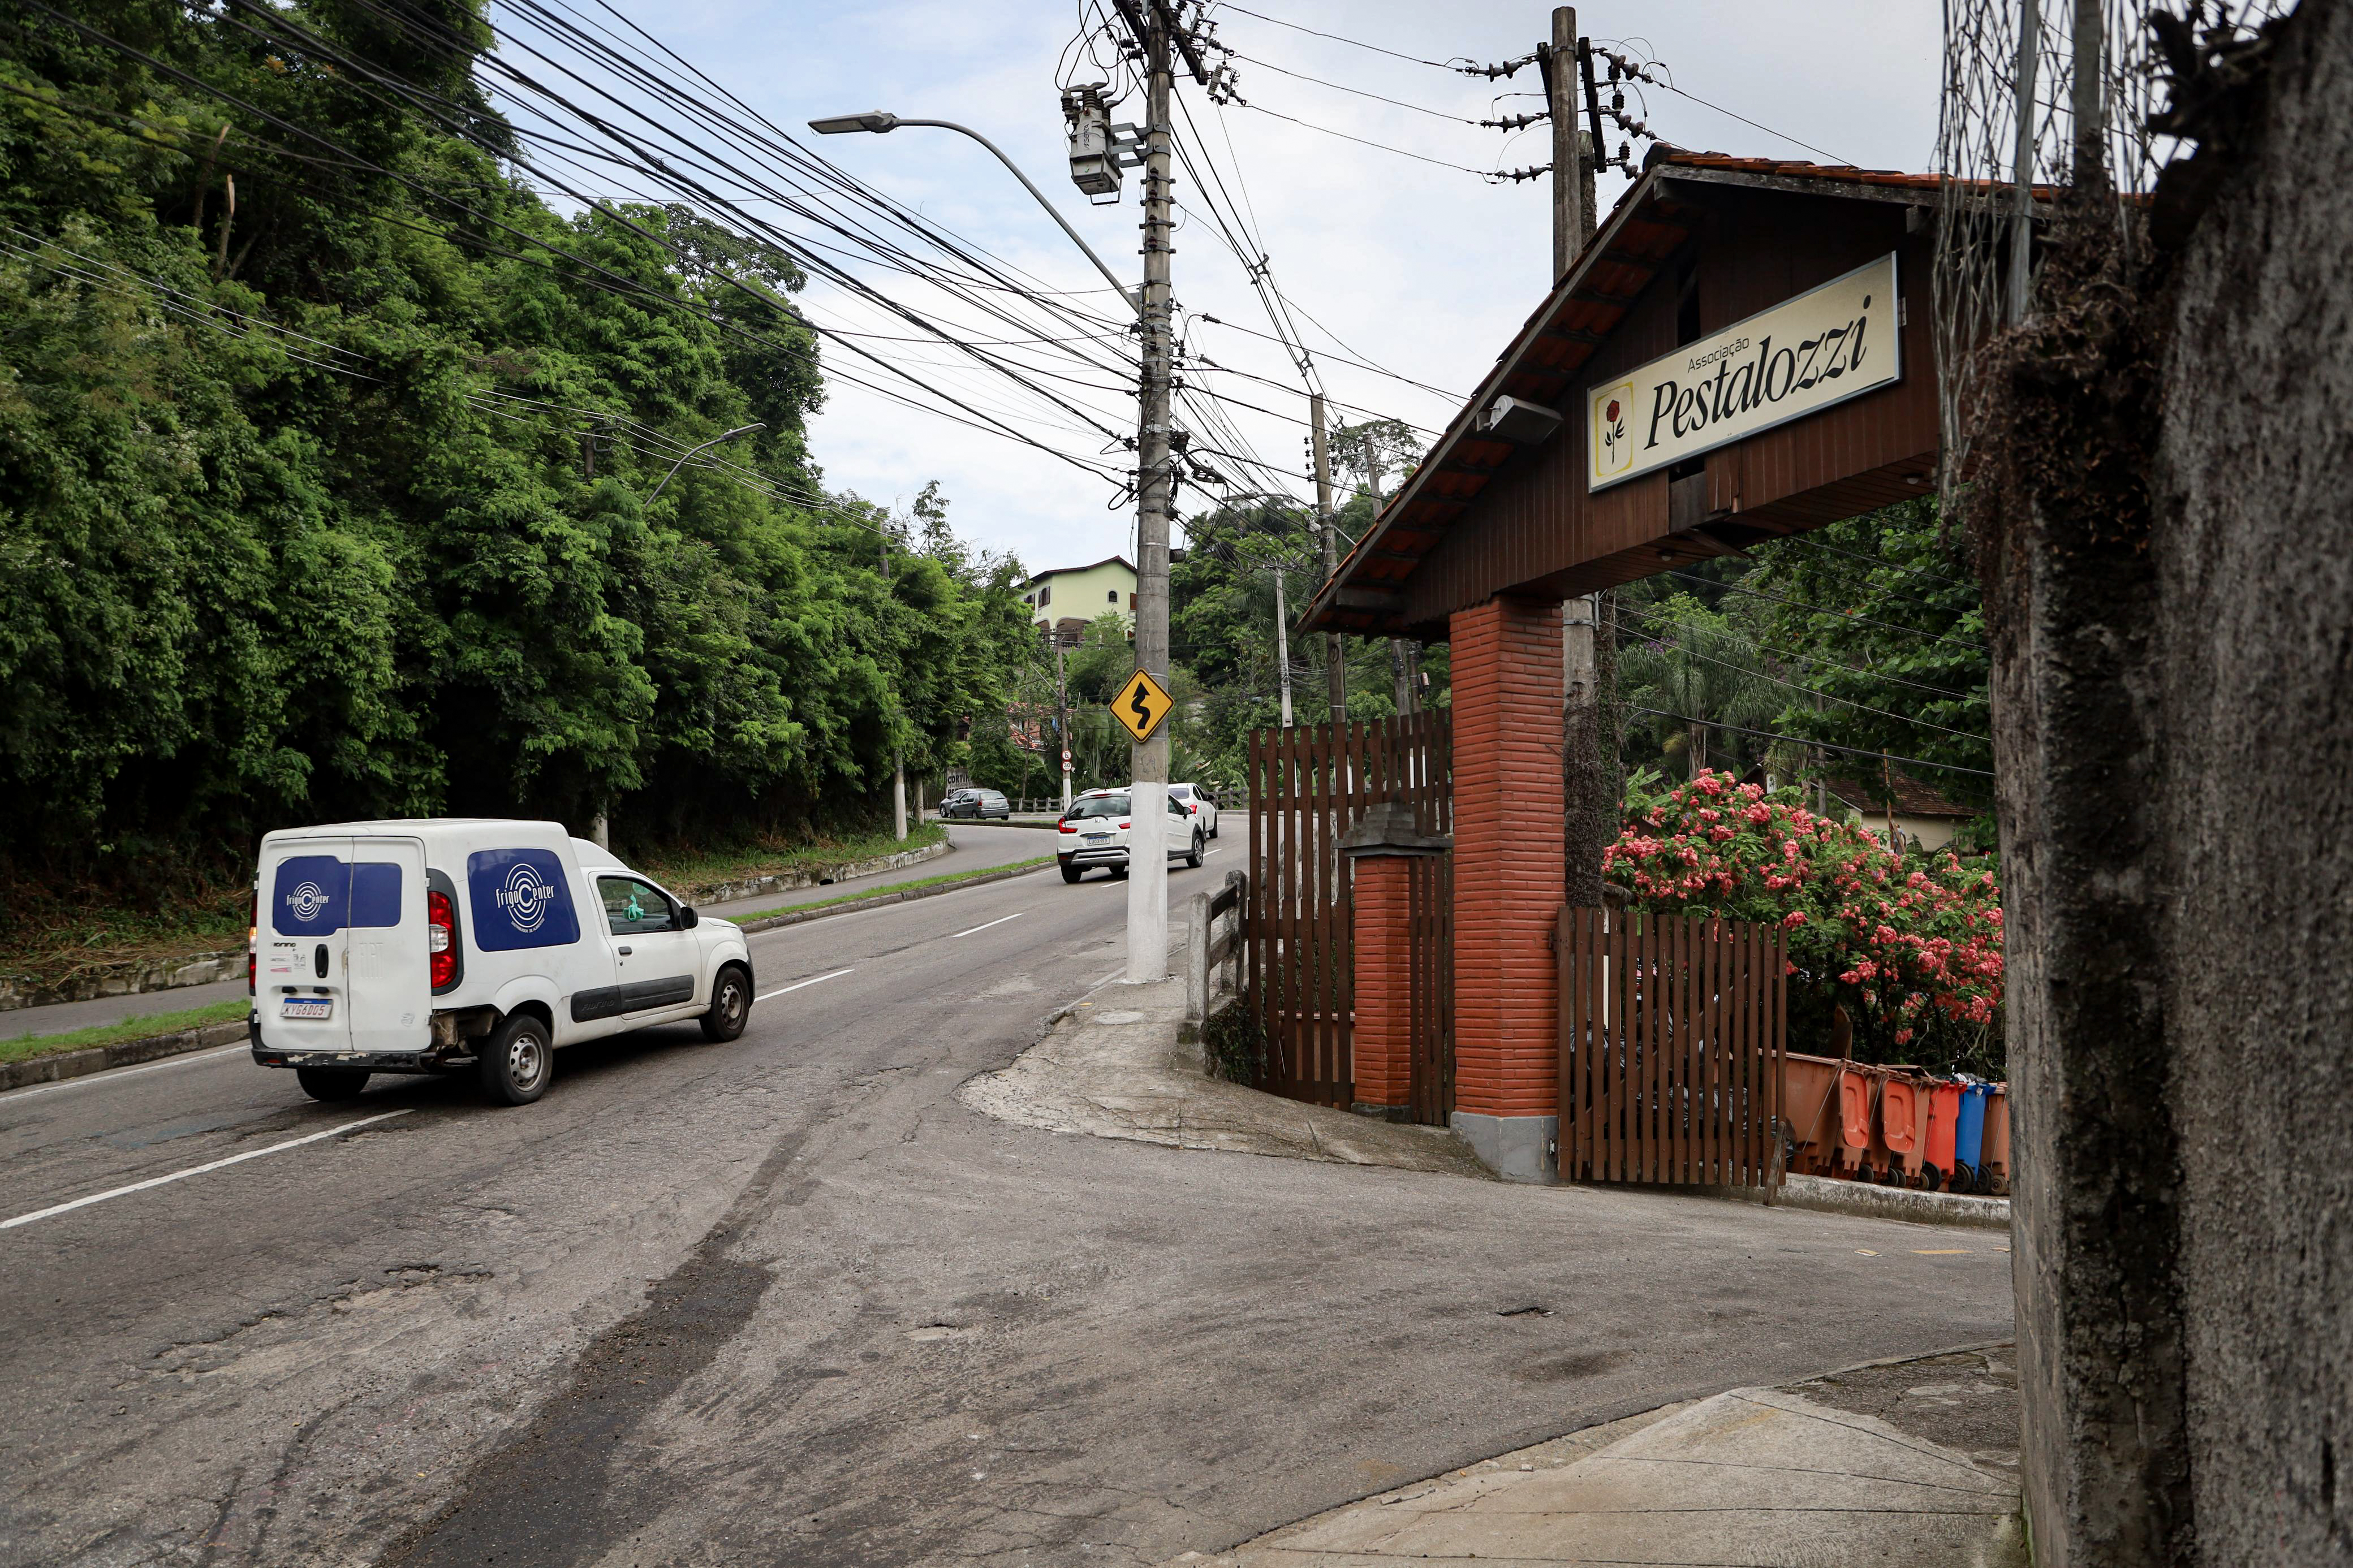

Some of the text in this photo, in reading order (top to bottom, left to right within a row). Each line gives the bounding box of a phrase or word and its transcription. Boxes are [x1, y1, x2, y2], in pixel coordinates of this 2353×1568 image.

[1644, 295, 1871, 450] Pestalozzi
[1687, 338, 1749, 373] Associação
[948, 773, 972, 784] CORTIN
